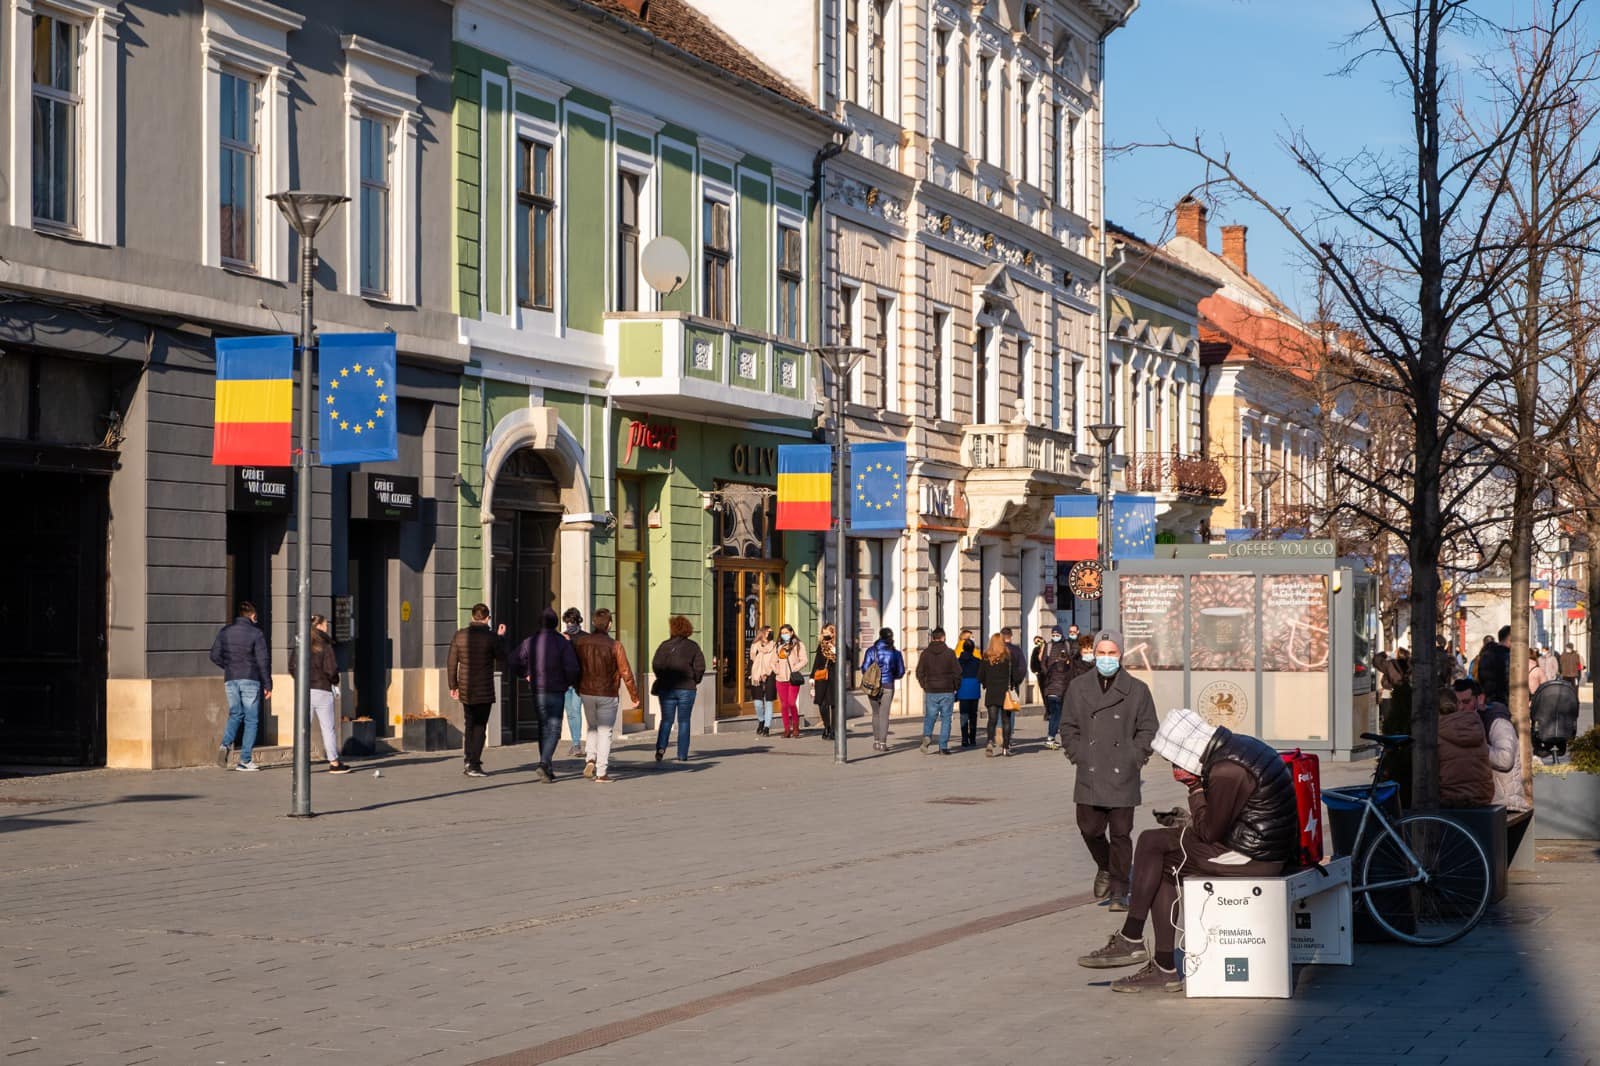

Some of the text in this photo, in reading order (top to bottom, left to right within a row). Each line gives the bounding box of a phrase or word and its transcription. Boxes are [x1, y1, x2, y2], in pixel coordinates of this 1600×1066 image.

[733, 443, 776, 477] OLIV
[1228, 542, 1333, 556] COFFEE YOU GO
[1075, 589, 1101, 599] OLIVO
[1219, 937, 1266, 945] CLUJ-NAPOCA
